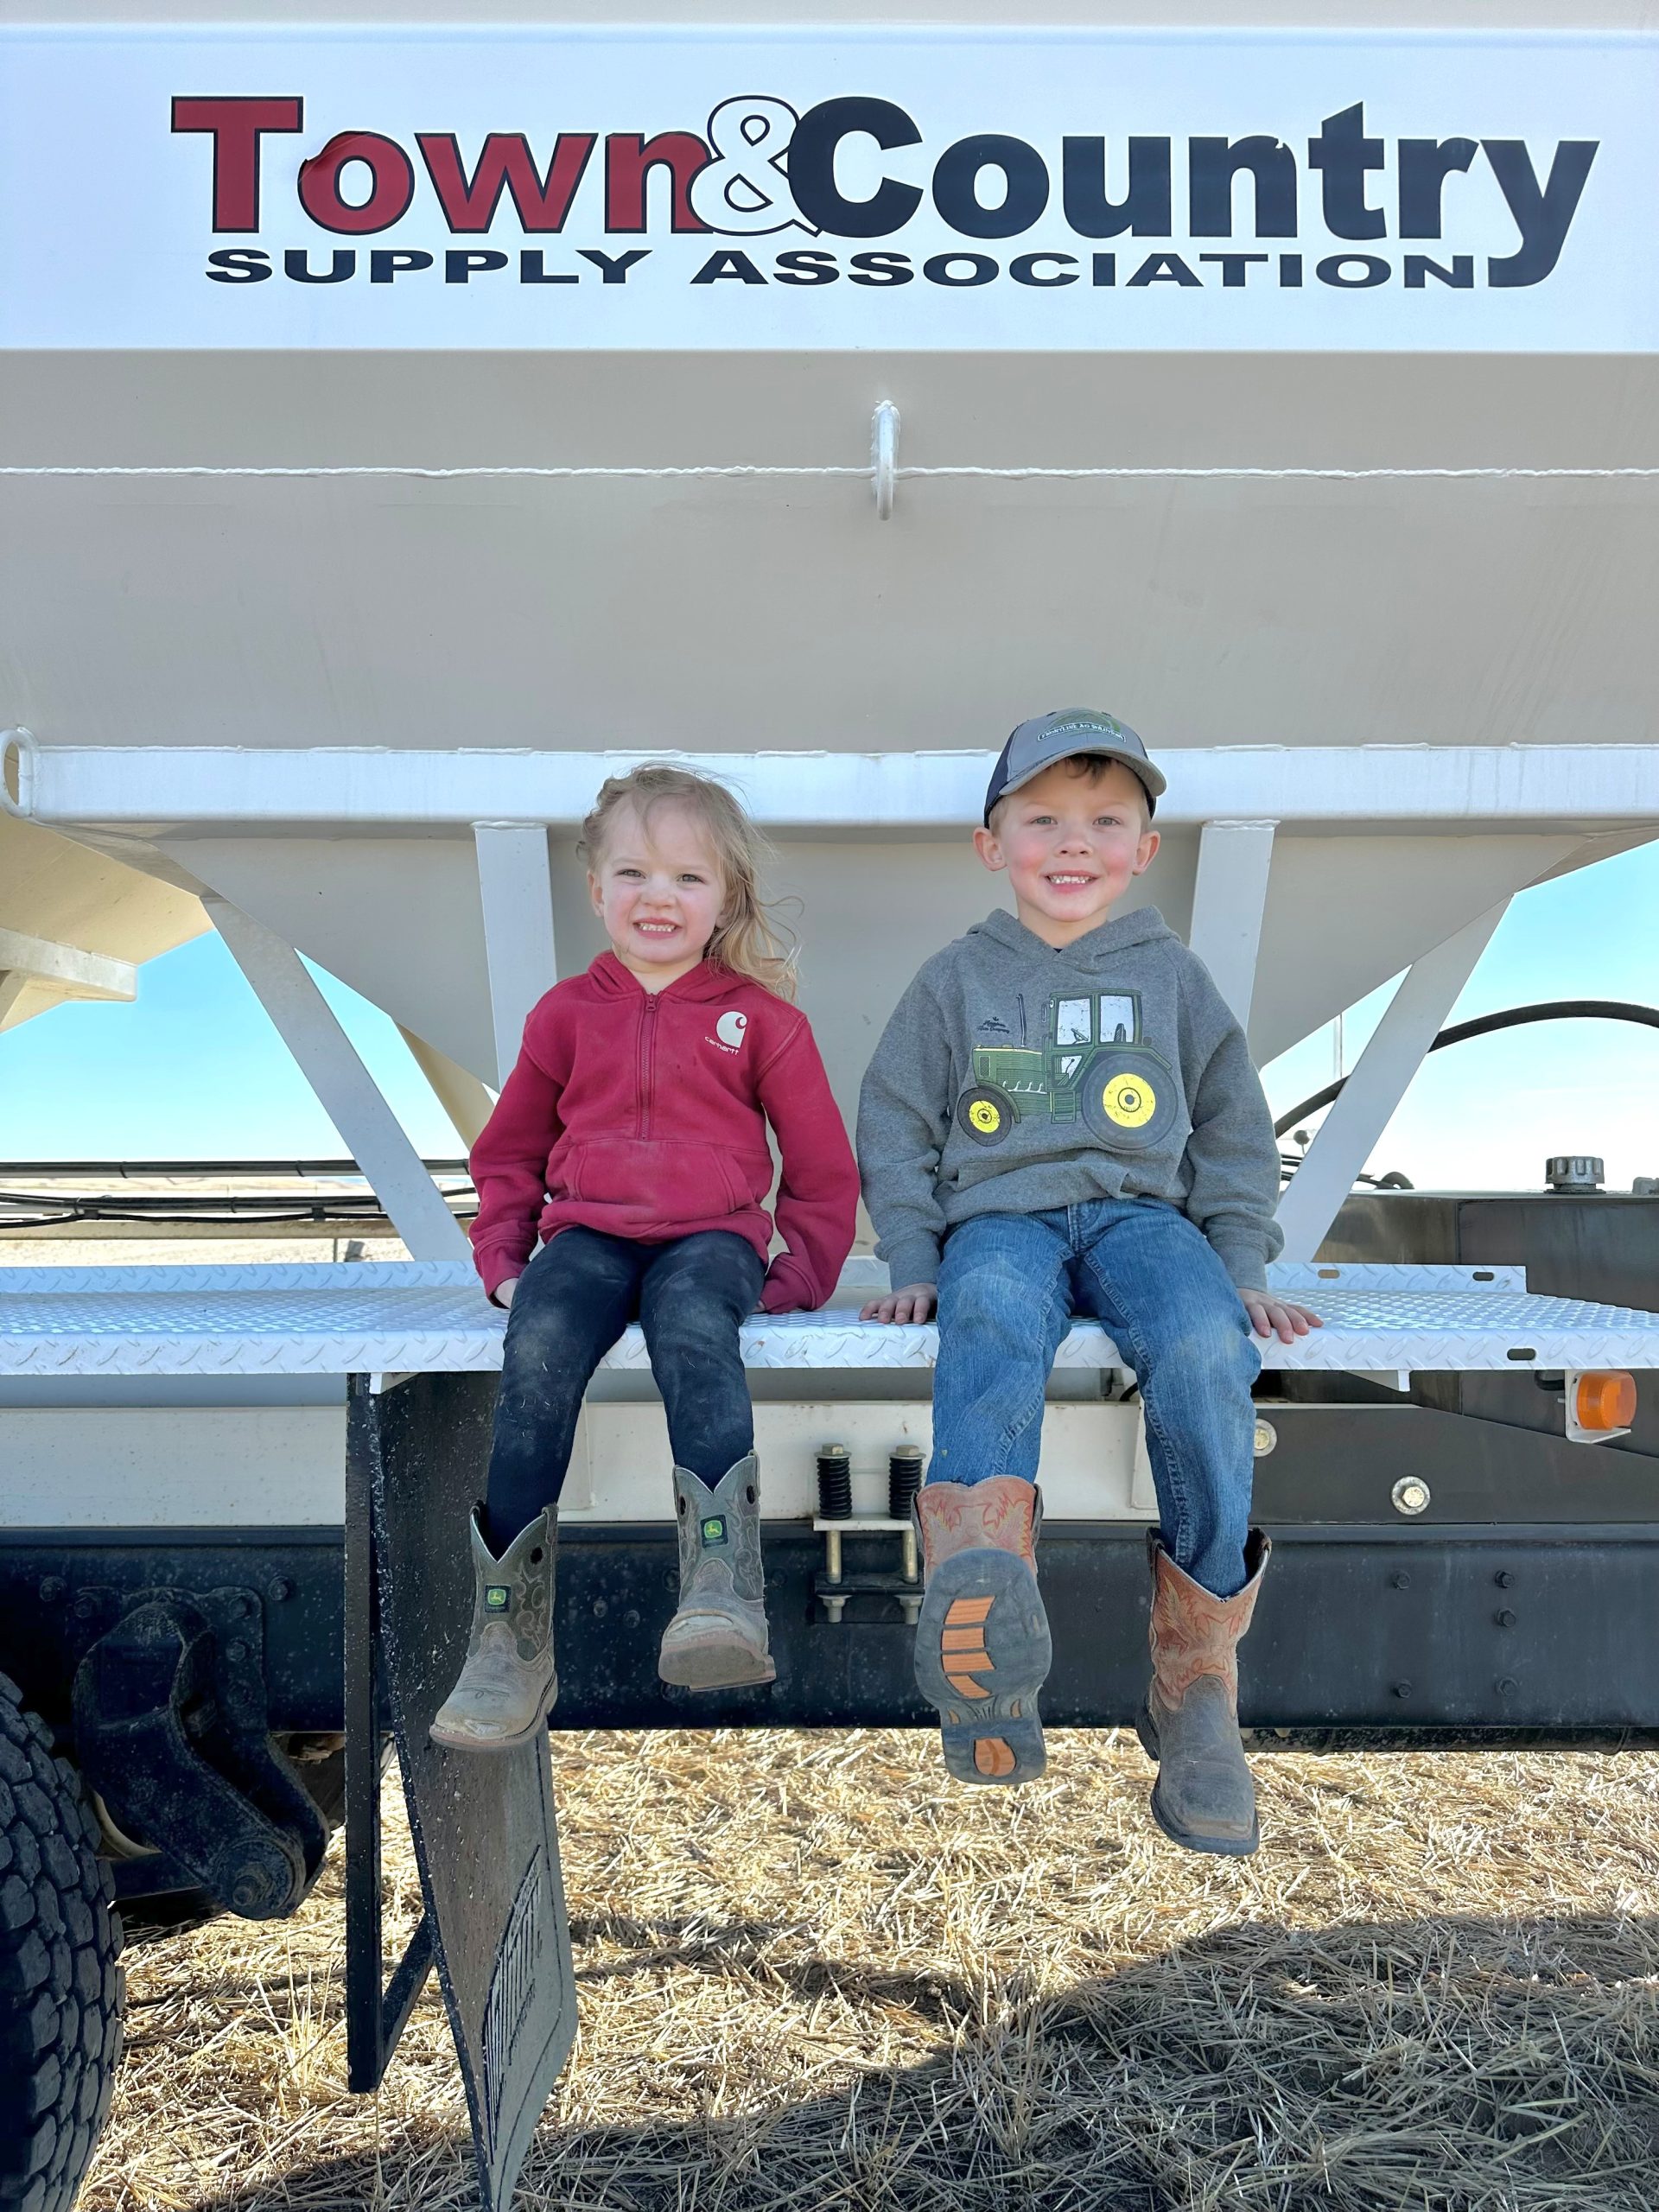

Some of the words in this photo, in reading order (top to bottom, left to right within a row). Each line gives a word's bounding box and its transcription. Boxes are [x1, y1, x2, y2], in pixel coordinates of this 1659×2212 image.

[204, 249, 653, 285] SUPPLY
[691, 251, 1475, 289] ASSOCIATION
[705, 1036, 739, 1056] carhartt
